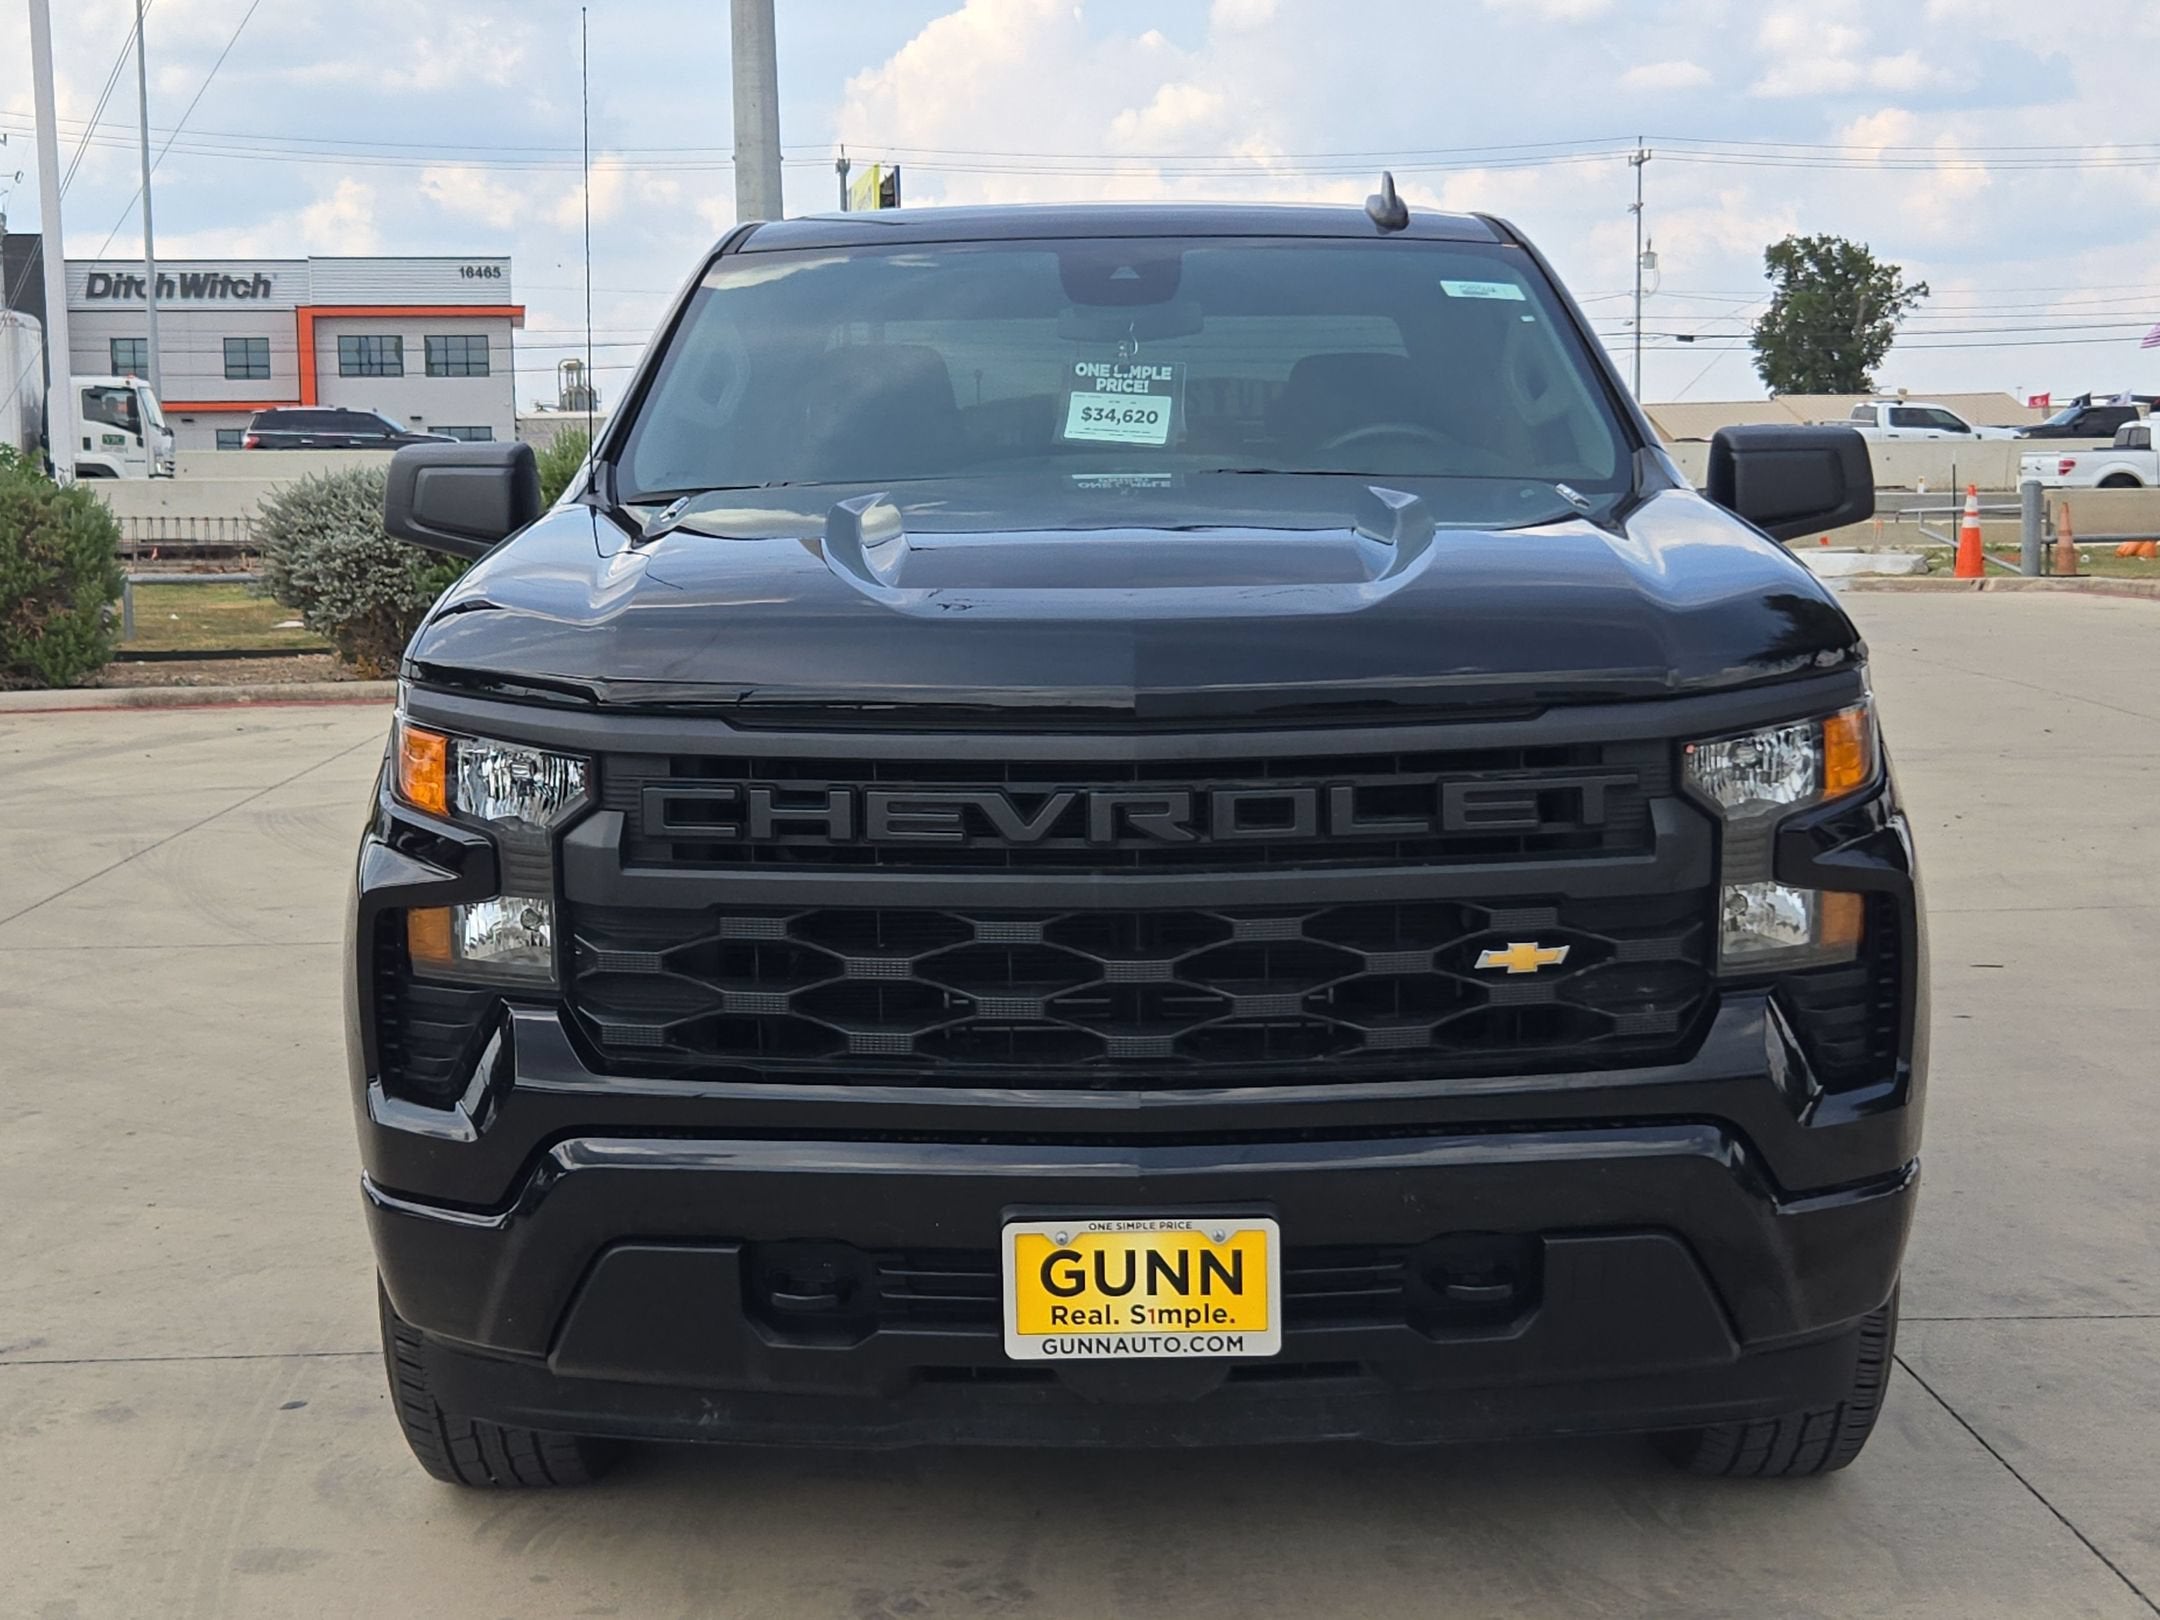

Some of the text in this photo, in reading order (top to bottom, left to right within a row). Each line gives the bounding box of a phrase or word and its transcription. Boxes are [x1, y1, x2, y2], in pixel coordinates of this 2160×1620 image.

[460, 265, 502, 279] 16465
[85, 272, 272, 300] Ditch Witch
[1075, 362, 1173, 380] ONE SMPLE
[1096, 378, 1149, 393] PRICE!
[1081, 406, 1158, 425] $34,620
[640, 772, 1640, 843] CHEVROLET
[1088, 1221, 1193, 1231] ONE SIMPLE PRICE
[1040, 1249, 1243, 1297] GUNN
[1051, 1305, 1120, 1325] Real.
[1042, 1336, 1244, 1355] GUNNAUTO.COM
